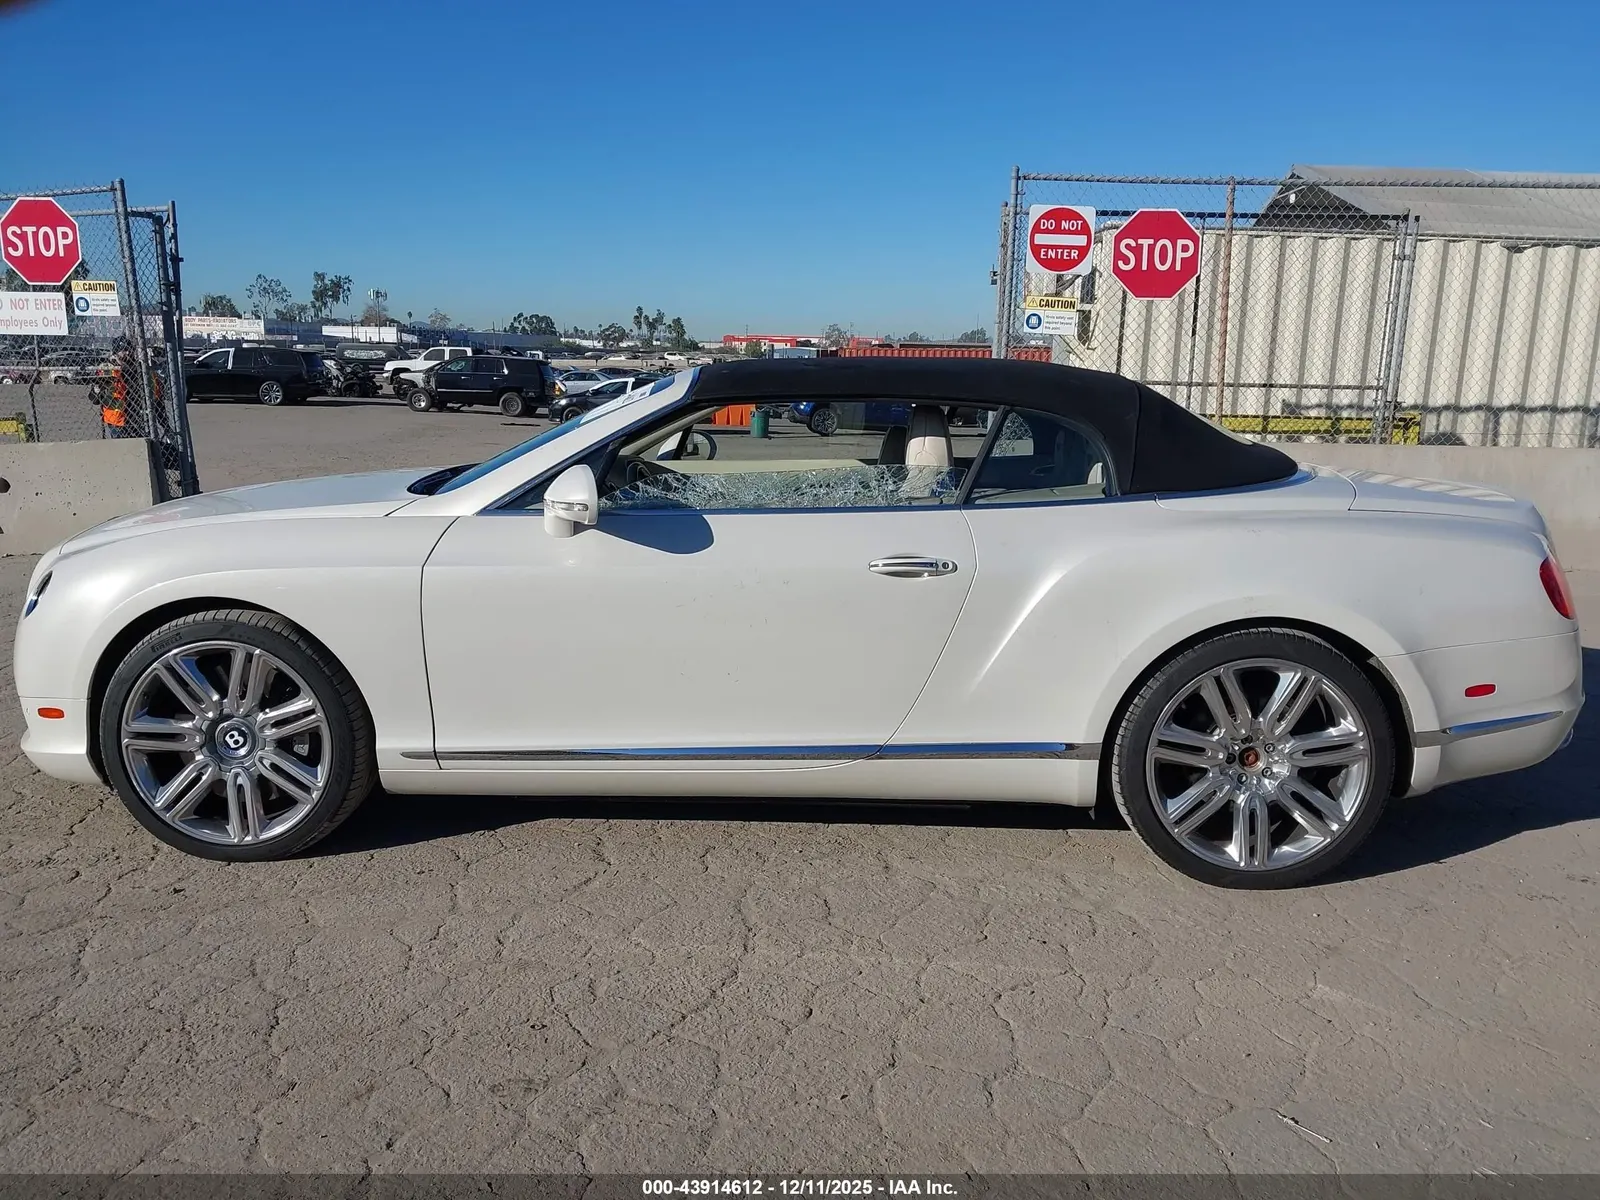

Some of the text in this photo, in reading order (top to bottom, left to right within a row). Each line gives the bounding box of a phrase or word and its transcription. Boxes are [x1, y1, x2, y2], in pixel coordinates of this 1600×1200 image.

[1040, 219, 1083, 231] DO NOT
[6, 225, 74, 258] STOP
[1040, 248, 1079, 260] ENTER
[1117, 238, 1195, 271] STOP
[83, 282, 115, 292] CAUTION
[10, 298, 29, 310] NOT
[34, 298, 63, 311] ENTER
[1039, 298, 1076, 310] CAUTION
[42, 316, 63, 331] Only
